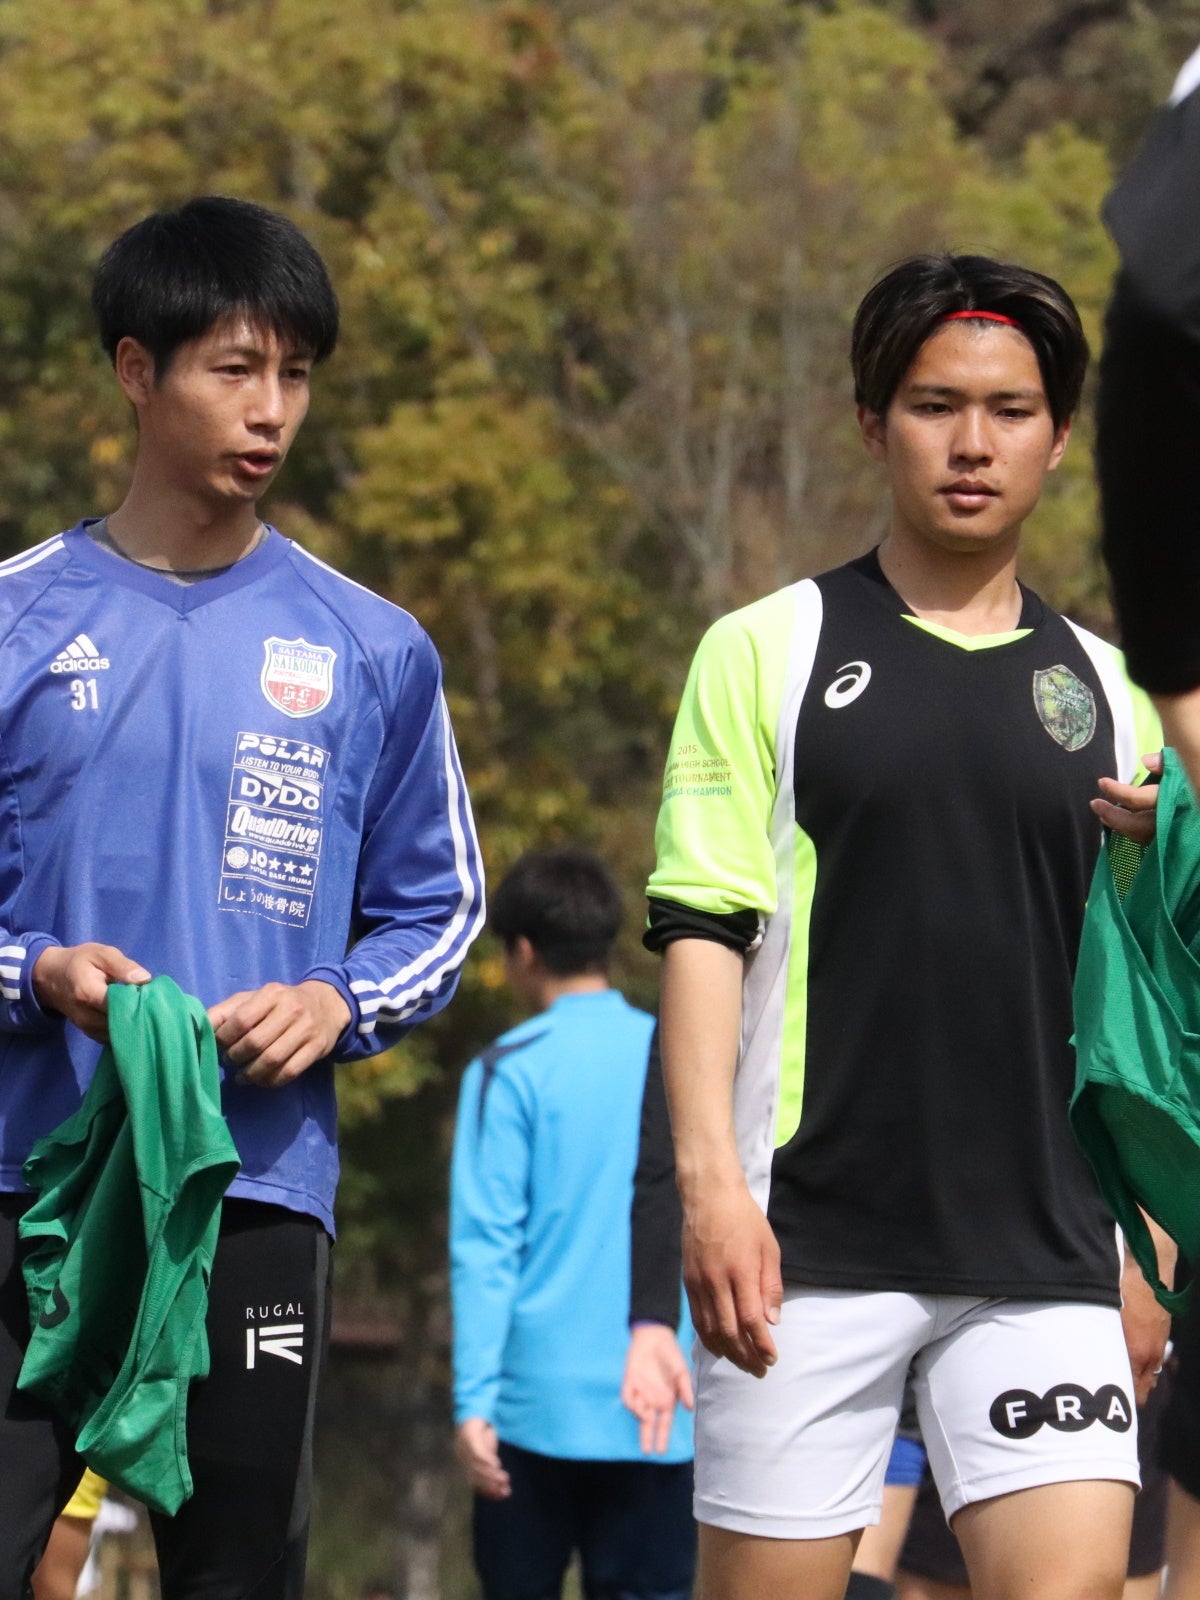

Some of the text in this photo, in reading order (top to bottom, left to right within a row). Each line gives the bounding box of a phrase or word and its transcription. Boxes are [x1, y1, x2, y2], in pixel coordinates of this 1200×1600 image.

[278, 646, 323, 661] SAITAMA
[50, 658, 110, 673] adidas
[273, 655, 324, 676] SAIKODAI
[71, 678, 98, 710] 31
[239, 735, 324, 768] POLAR
[677, 745, 697, 755] 2015
[241, 756, 267, 768] LISTEN
[269, 761, 279, 770] TO
[281, 764, 302, 776] YOUR
[675, 772, 732, 783] TOURNAMENT
[241, 776, 319, 810] DyDo
[687, 786, 732, 796] CHAMPION
[231, 806, 319, 845] QuadDrive
[269, 872, 286, 880] BASE
[225, 887, 305, 917] しょうの接骨院
[246, 1303, 304, 1319] RUGAL
[1006, 1395, 1128, 1429] FRA
